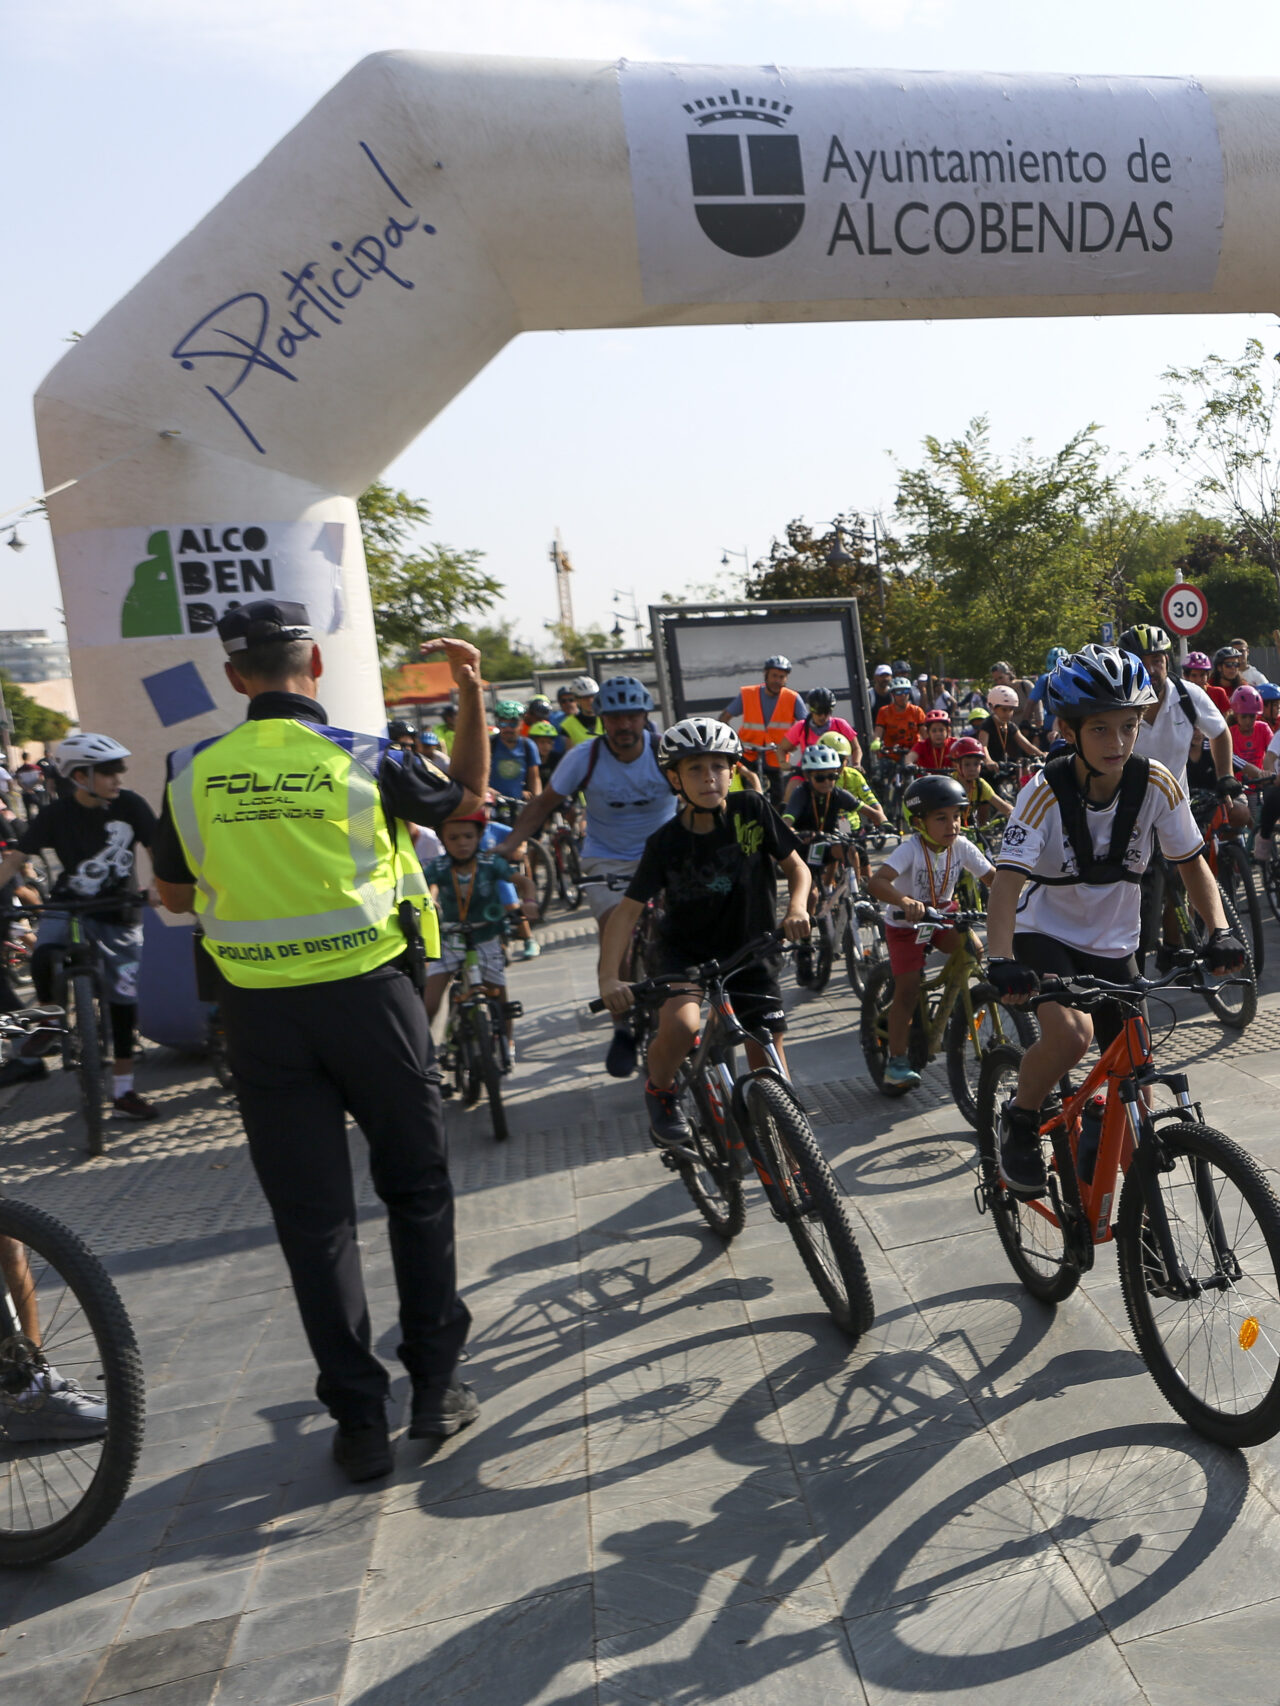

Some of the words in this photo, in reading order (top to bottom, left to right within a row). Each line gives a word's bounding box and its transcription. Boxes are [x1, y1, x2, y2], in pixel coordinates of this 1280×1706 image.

[822, 135, 1107, 199] Ayuntamiento
[1126, 138, 1173, 184] de
[826, 201, 1174, 256] ALCOBENDAS
[178, 526, 268, 554] ALCO
[179, 558, 276, 595] BEN
[1173, 601, 1198, 618] 30
[205, 766, 334, 797] POLICÍA
[211, 808, 326, 825] ALCOBENDAS
[238, 796, 295, 806] LOCAL
[217, 944, 276, 962] POLICÍA
[277, 944, 302, 958] DE
[303, 927, 379, 953] DISTRITO
